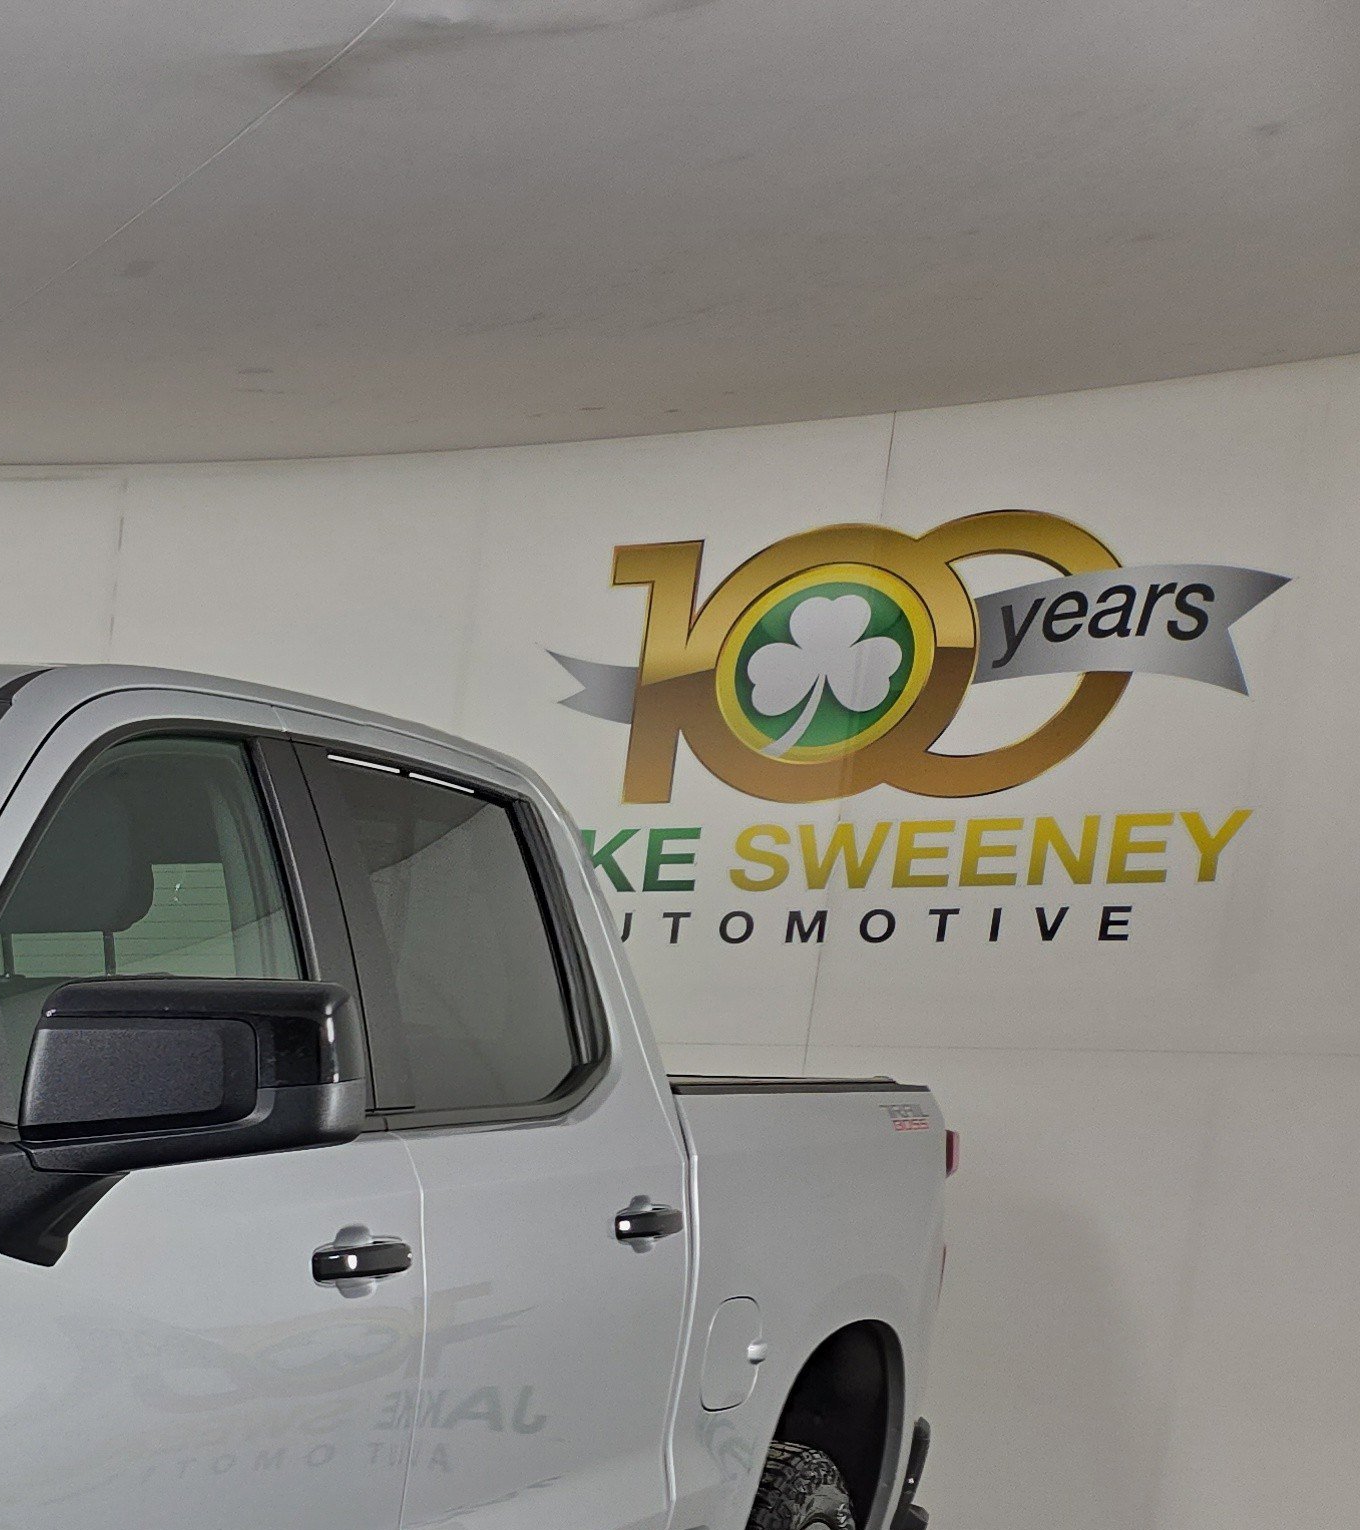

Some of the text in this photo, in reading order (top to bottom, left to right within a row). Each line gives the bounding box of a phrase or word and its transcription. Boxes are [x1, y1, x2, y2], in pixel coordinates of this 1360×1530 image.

[990, 580, 1215, 669] years
[580, 809, 1253, 893] KE SWEENEY
